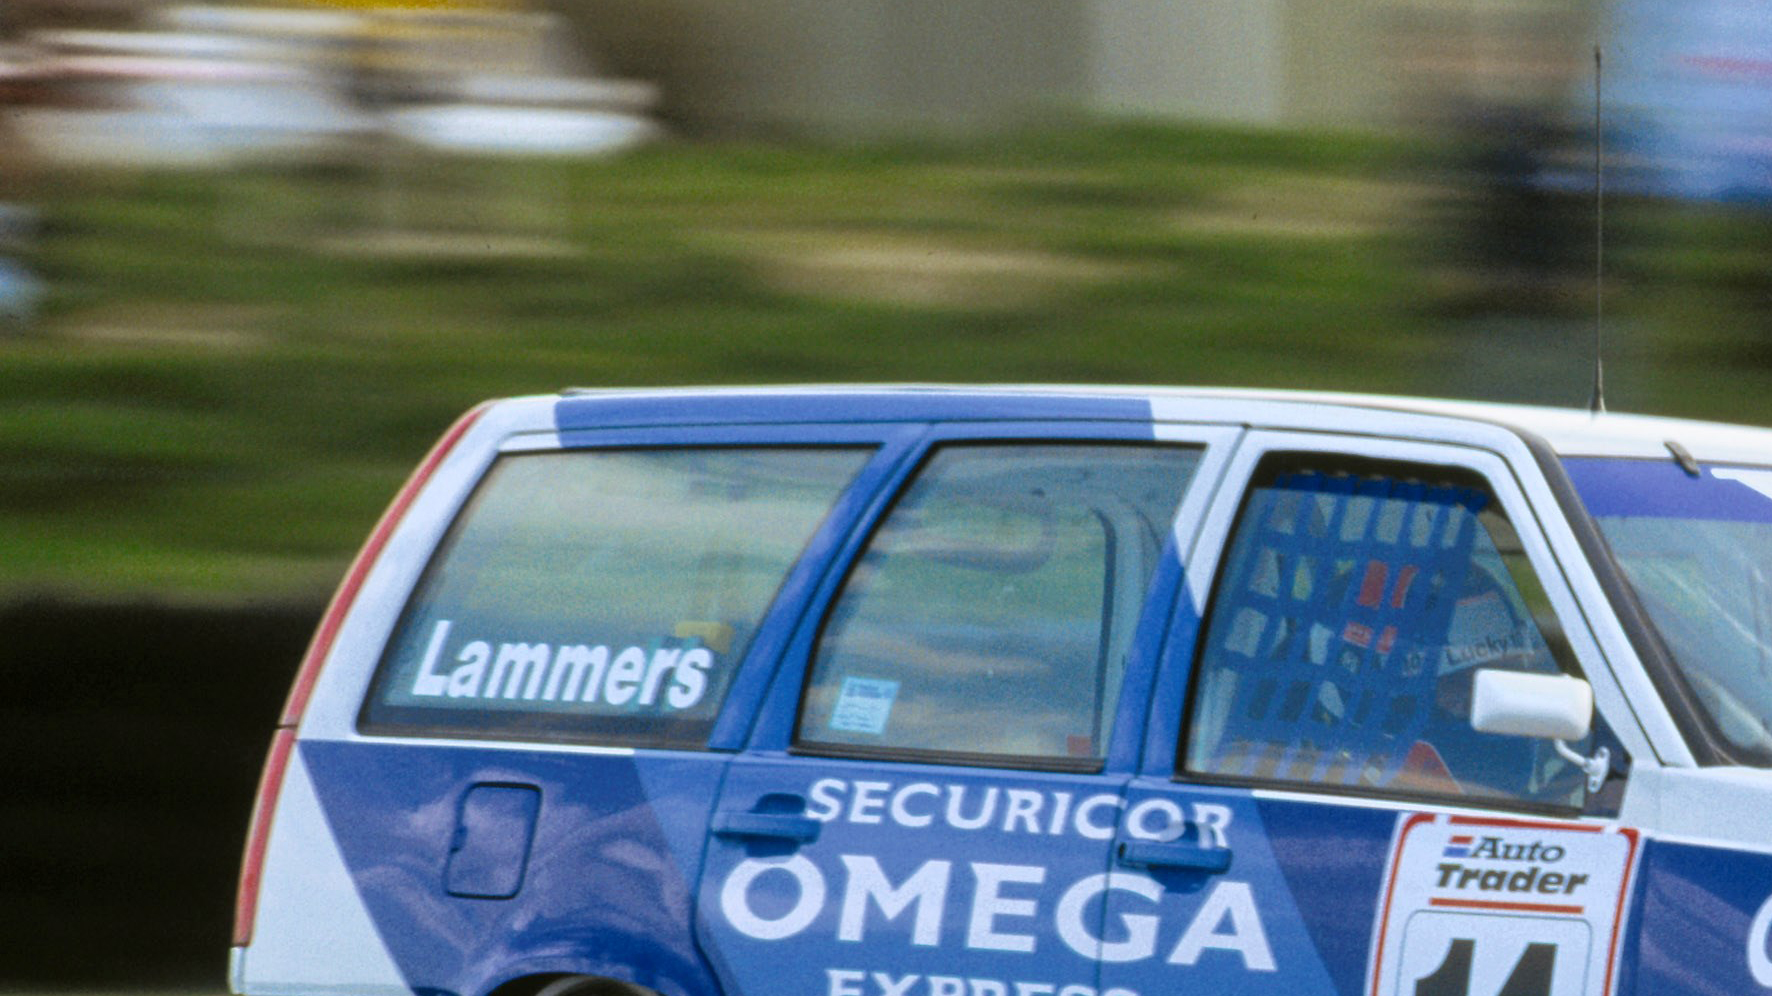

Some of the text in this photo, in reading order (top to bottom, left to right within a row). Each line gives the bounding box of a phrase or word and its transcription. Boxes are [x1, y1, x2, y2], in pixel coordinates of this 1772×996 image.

[412, 620, 715, 710] Lammers
[806, 778, 1233, 848] SECURICOR
[1434, 862, 1590, 895] Trader
[1469, 836, 1566, 863] Auto
[720, 853, 1278, 972] OMEGA
